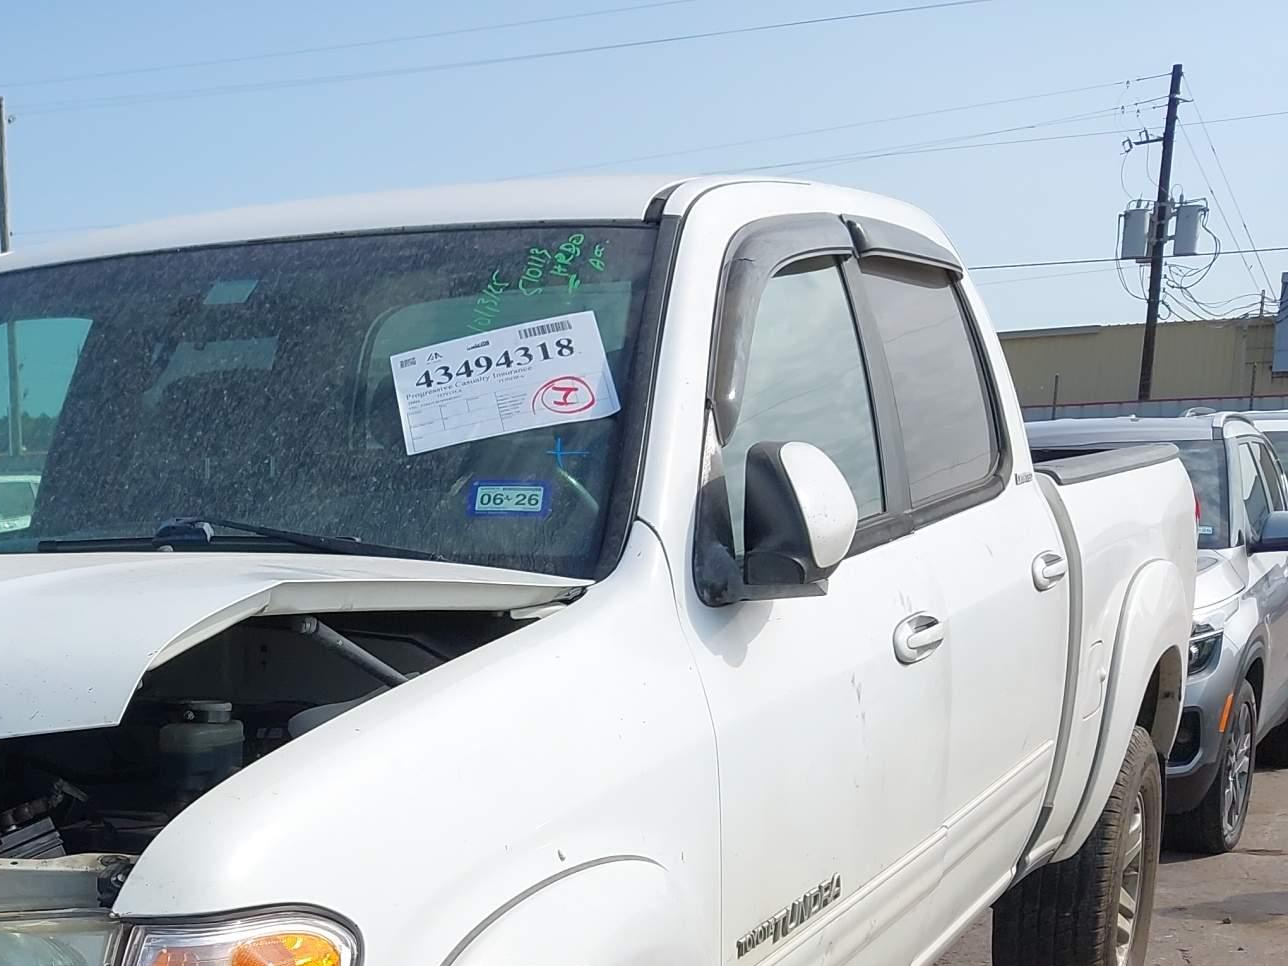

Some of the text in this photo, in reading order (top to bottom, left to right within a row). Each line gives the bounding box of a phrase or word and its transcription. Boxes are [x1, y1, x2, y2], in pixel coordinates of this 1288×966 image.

[406, 382, 453, 400] Progressive
[454, 373, 492, 388] Casualty
[492, 365, 533, 380] Insurance
[415, 337, 575, 389] 43494318
[772, 871, 841, 945] TUNDRA
